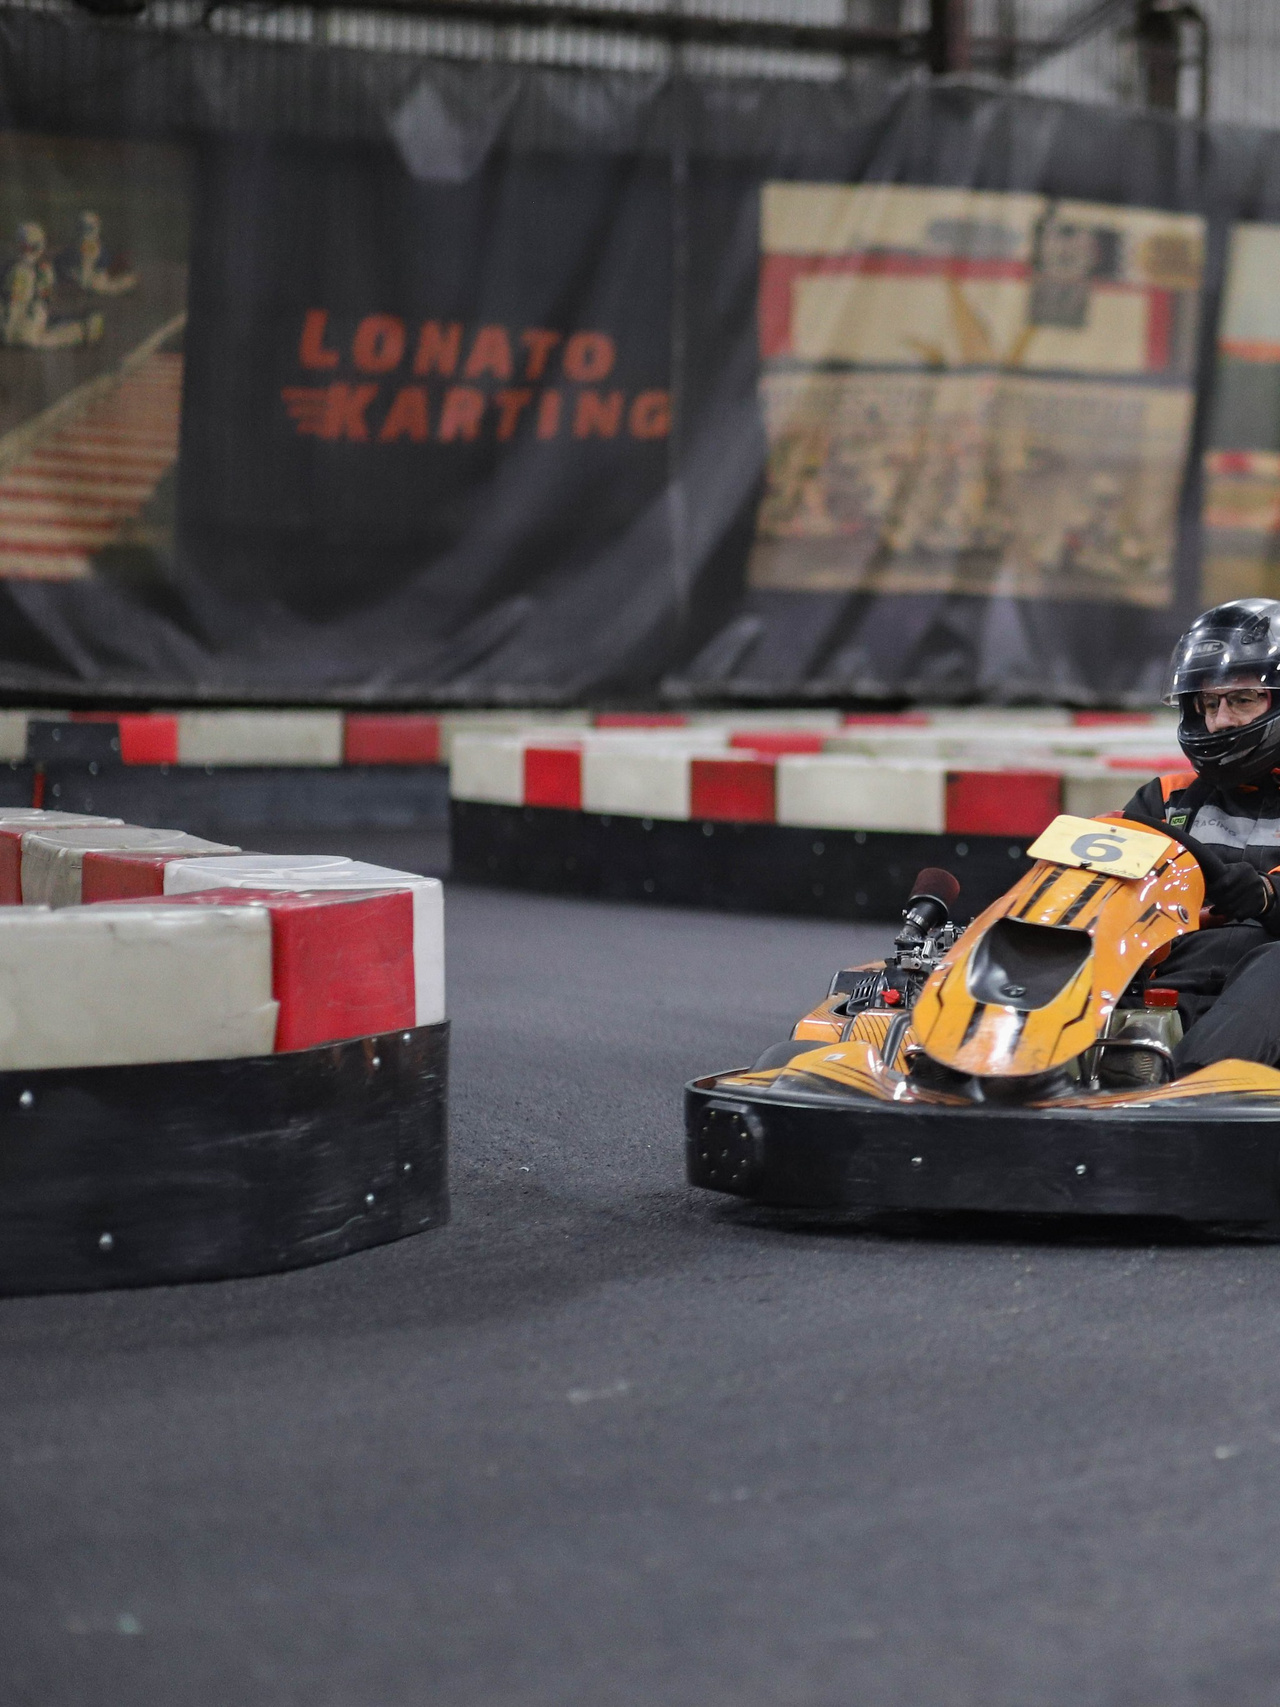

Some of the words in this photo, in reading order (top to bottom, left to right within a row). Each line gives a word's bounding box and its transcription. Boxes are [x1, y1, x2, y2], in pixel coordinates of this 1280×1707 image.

[300, 308, 617, 383] LONATO
[306, 382, 674, 444] KARTING
[1070, 833, 1128, 863] 6
[1193, 819, 1237, 837] RACING
